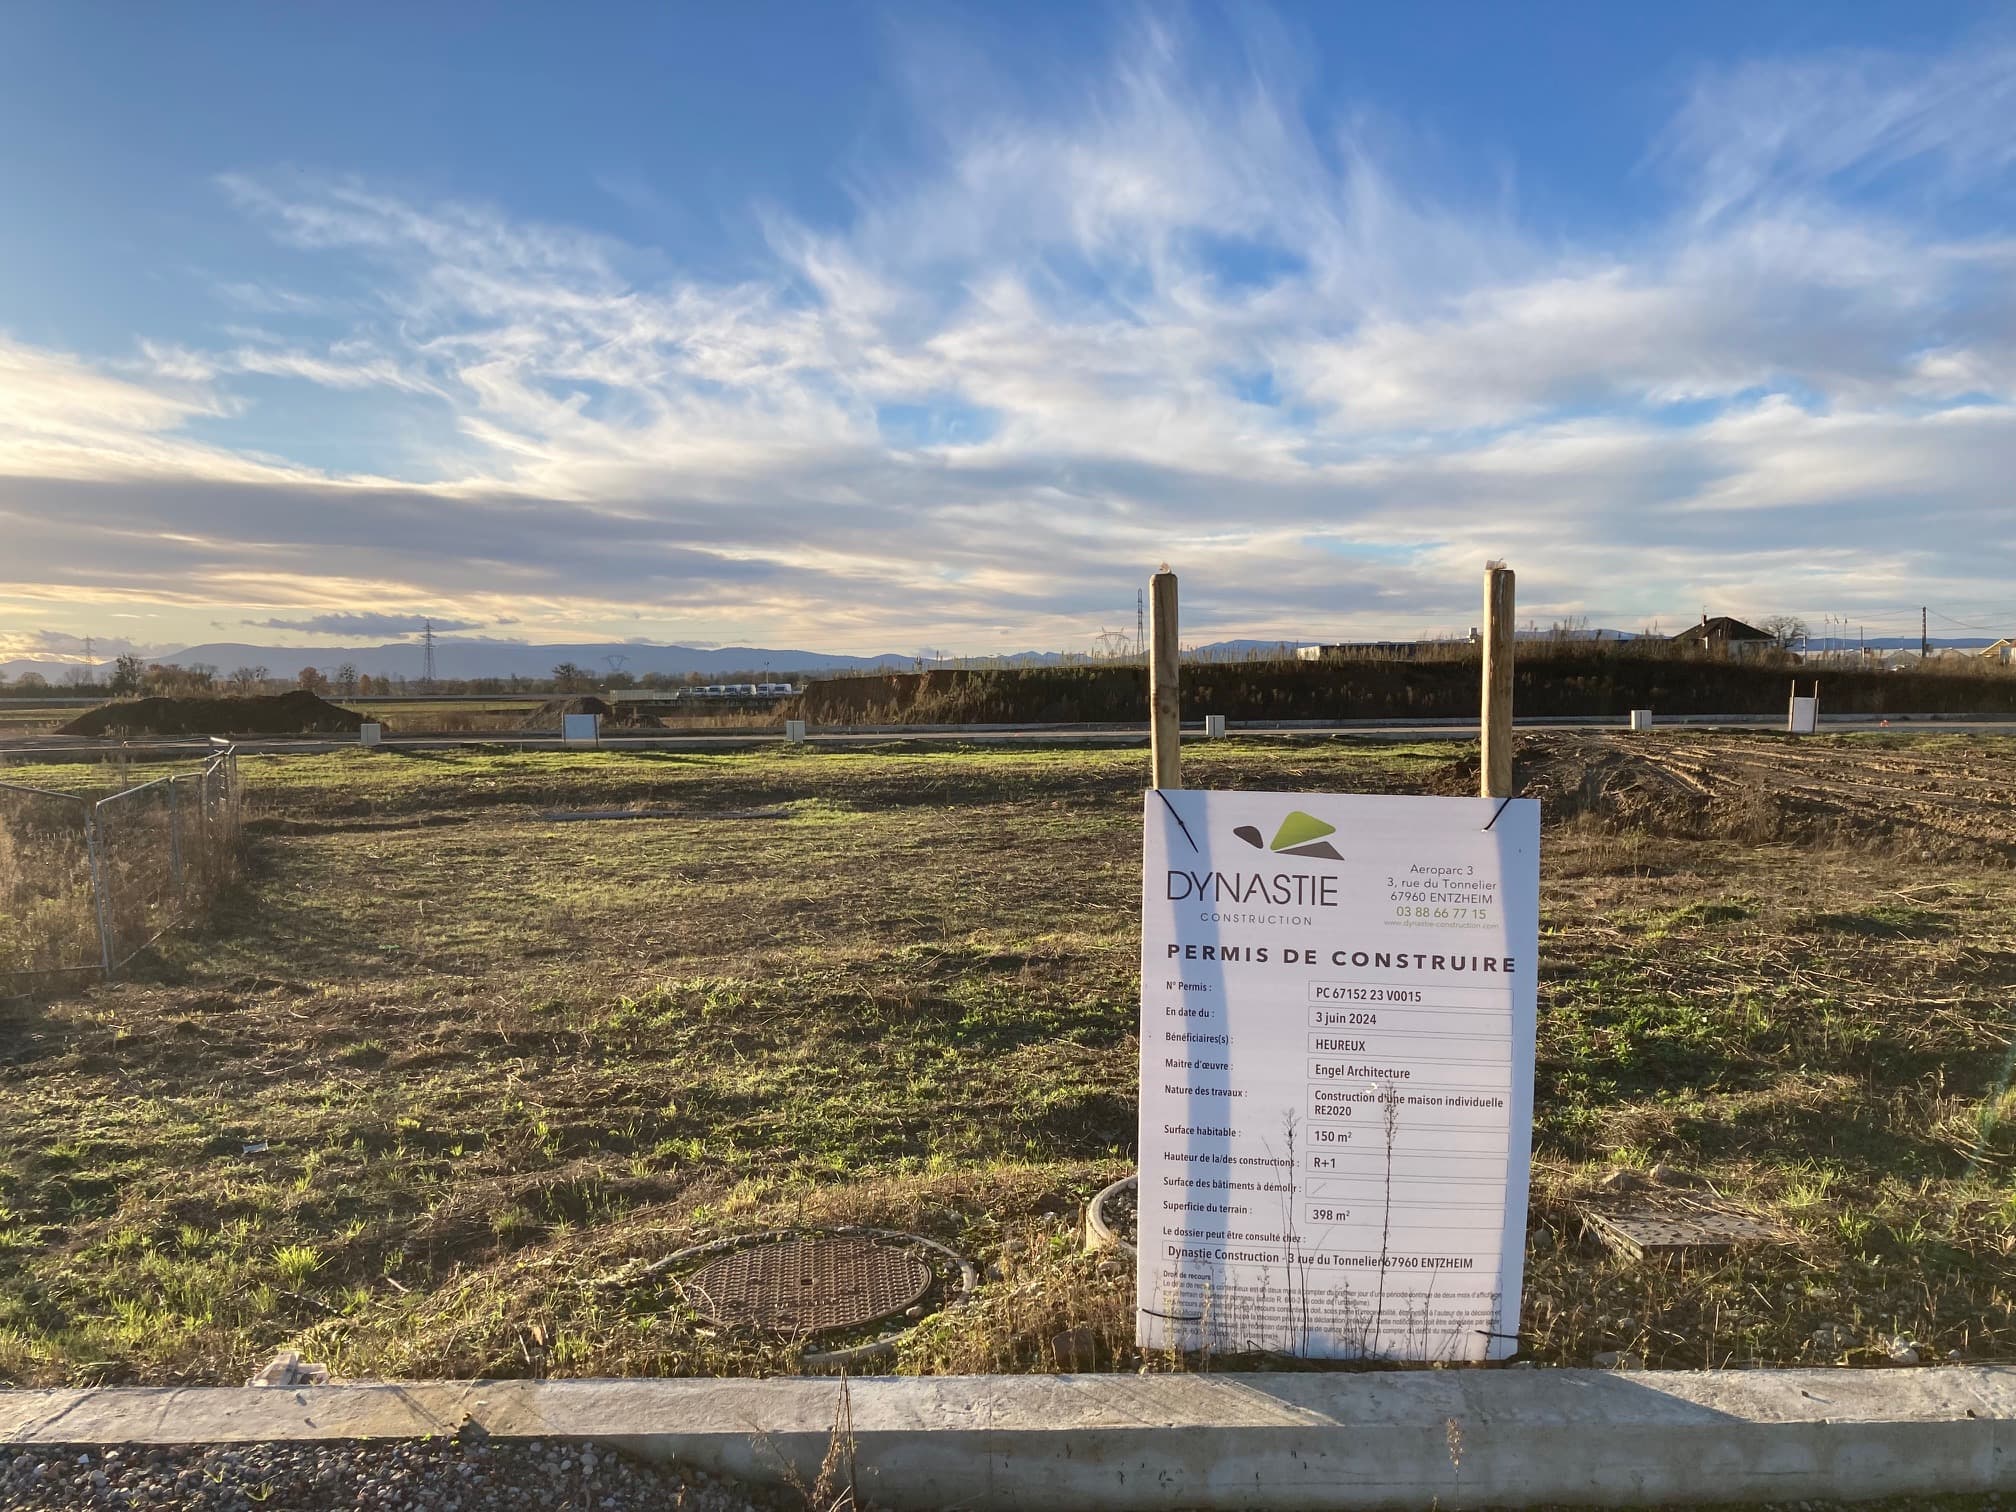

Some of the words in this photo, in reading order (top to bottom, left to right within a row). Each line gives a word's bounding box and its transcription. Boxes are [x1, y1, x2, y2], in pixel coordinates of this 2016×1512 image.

[1410, 864, 1463, 877] Aeroparc
[1467, 866, 1474, 876] 3
[1167, 871, 1339, 907] DYNASTIE
[1387, 877, 1397, 888] 3,
[1401, 880, 1420, 888] rue
[1424, 878, 1439, 888] du
[1442, 879, 1497, 890] Tonnelier
[1390, 891, 1426, 902] 67960
[1430, 892, 1493, 904] ENTZHEIM
[1200, 912, 1313, 927] CONSTRUCTION
[1396, 906, 1411, 917] 03
[1415, 907, 1430, 918] 88
[1434, 908, 1449, 918] 66
[1453, 908, 1467, 919] 77
[1472, 909, 1487, 920] 15
[1384, 920, 1499, 929] www.dynastie-construction.com
[1167, 944, 1270, 963] PERMIS
[1283, 949, 1318, 965] DE
[1332, 950, 1516, 973] CONSTRUIRE
[1166, 981, 1176, 990] N°
[1178, 981, 1207, 992] Permis
[1316, 987, 1330, 999] PC
[1332, 988, 1367, 1000] 67152
[1370, 990, 1384, 1001] 23
[1386, 990, 1422, 1002] V0015
[1166, 1007, 1176, 1016] En
[1178, 1007, 1197, 1017] date
[1199, 1008, 1210, 1018] du
[1316, 1012, 1323, 1023] 3
[1325, 1012, 1346, 1026] juin
[1349, 1013, 1377, 1025] 2024
[1165, 1032, 1229, 1046] Bénéficiaires(s)
[1316, 1039, 1366, 1052] HEUREUX
[1315, 1064, 1344, 1079] Engel
[1347, 1065, 1411, 1079] Architecture
[1165, 1084, 1193, 1095] Nature
[1195, 1086, 1210, 1096] des
[1212, 1088, 1243, 1097] travaux
[1314, 1090, 1375, 1103] Construction
[1378, 1092, 1405, 1105] d'une
[1408, 1096, 1443, 1106] maison
[1445, 1096, 1504, 1108] individuelle
[1314, 1105, 1352, 1117] RE2020
[1164, 1125, 1195, 1135] Surface
[1196, 1126, 1237, 1138] habitable
[1314, 1130, 1335, 1142] 150
[1164, 1152, 1198, 1162] Hauteur
[1200, 1153, 1210, 1163] de
[1212, 1154, 1237, 1164] la/des
[1239, 1157, 1295, 1167] constructions
[1314, 1157, 1336, 1169] R+1
[1163, 1176, 1194, 1187] Surface
[1196, 1178, 1210, 1188] des
[1212, 1179, 1255, 1191] bâtiments
[1257, 1182, 1261, 1191] à
[1264, 1182, 1297, 1193] démolr
[1163, 1200, 1205, 1212] Superficie
[1206, 1203, 1218, 1213] du
[1220, 1204, 1248, 1214] terrain
[1313, 1209, 1333, 1221] 398
[1163, 1226, 1173, 1236] Le
[1174, 1227, 1203, 1238] dossier
[1206, 1230, 1225, 1241] peut
[1227, 1231, 1243, 1240] être
[1245, 1233, 1280, 1242] consulté
[1283, 1233, 1301, 1243] chez
[1168, 1246, 1212, 1260] Dynastie
[1214, 1249, 1279, 1263] Construction
[1288, 1253, 1294, 1264] 3
[1298, 1255, 1314, 1264] rue
[1317, 1254, 1331, 1265] du
[1333, 1255, 1383, 1267] Tonnelier
[1384, 1257, 1419, 1268] 67960
[1421, 1257, 1473, 1269] ENTZHEIM
